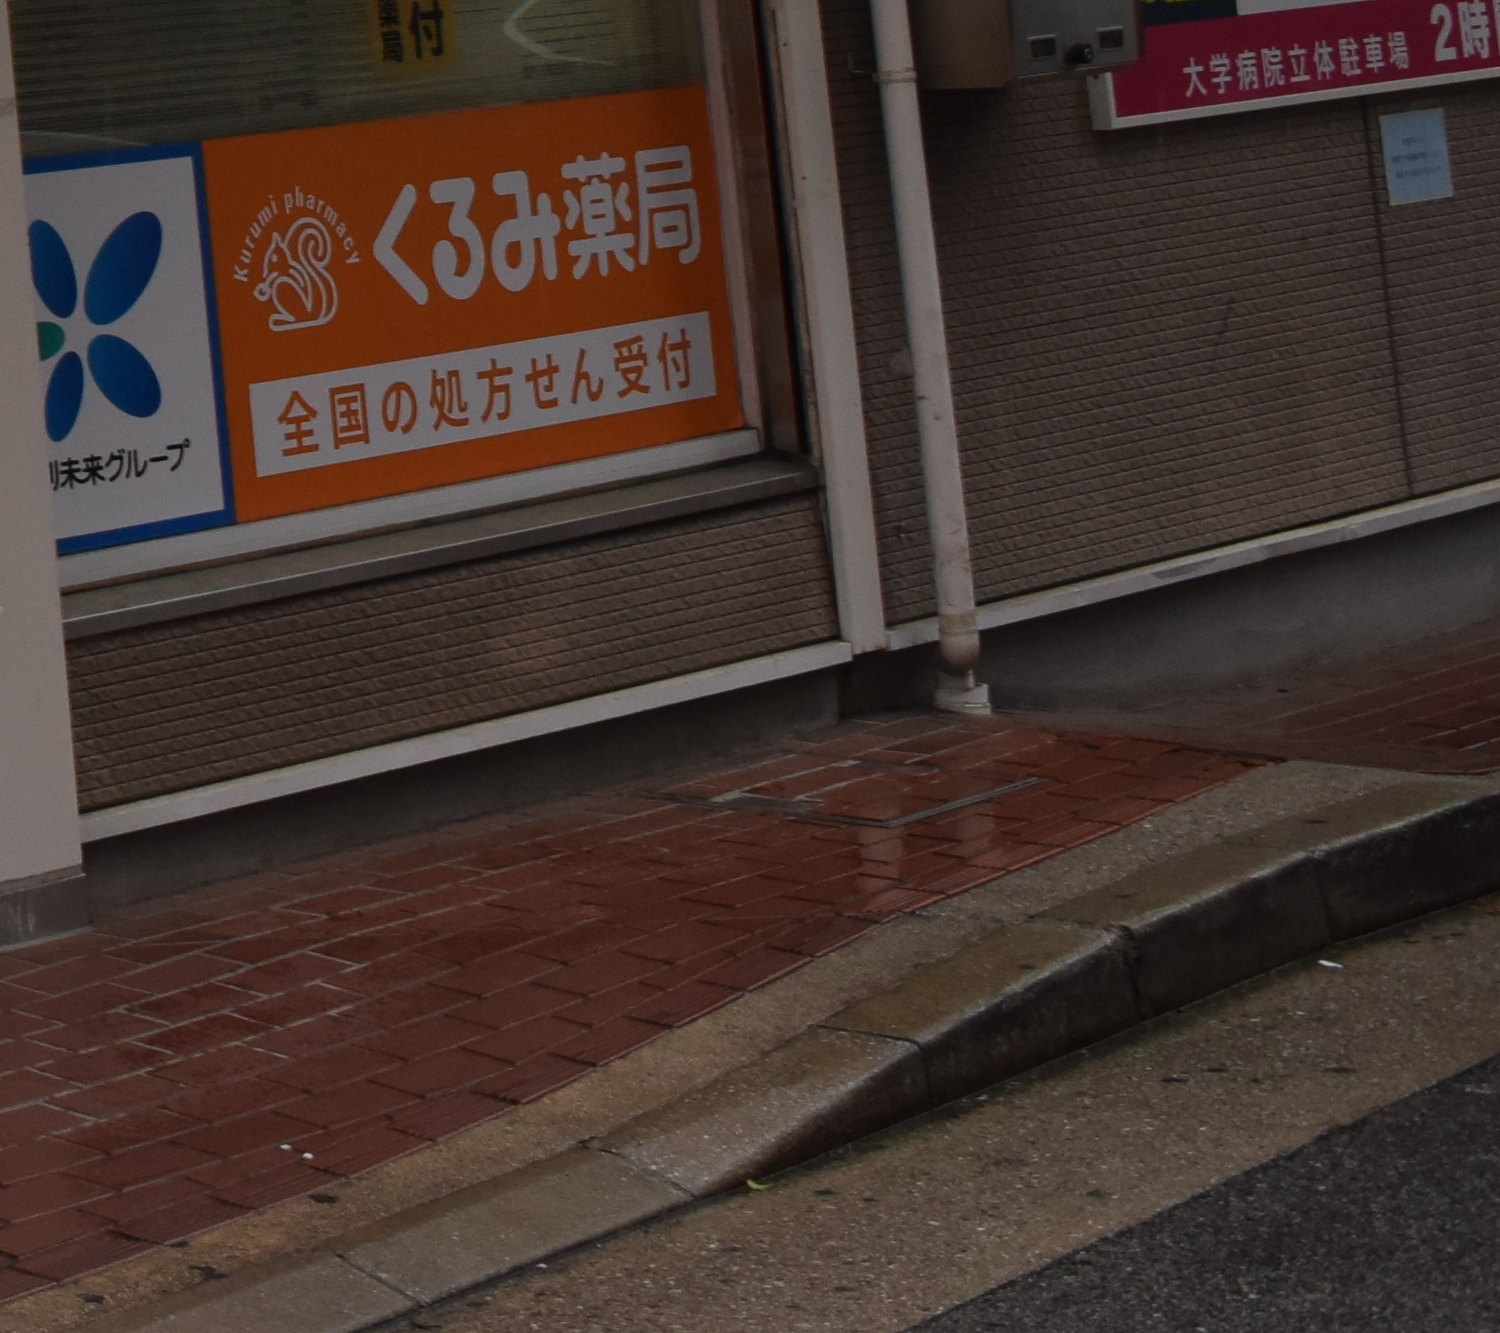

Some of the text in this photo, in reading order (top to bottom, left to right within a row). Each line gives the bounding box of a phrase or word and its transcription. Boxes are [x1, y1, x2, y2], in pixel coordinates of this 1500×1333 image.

[1182, 31, 1410, 98] 大学病院立体駐車場
[233, 185, 361, 282] Kurumi pharmacy
[371, 144, 702, 307] くるみ薬局
[276, 330, 693, 459] 全国の処方せん受付
